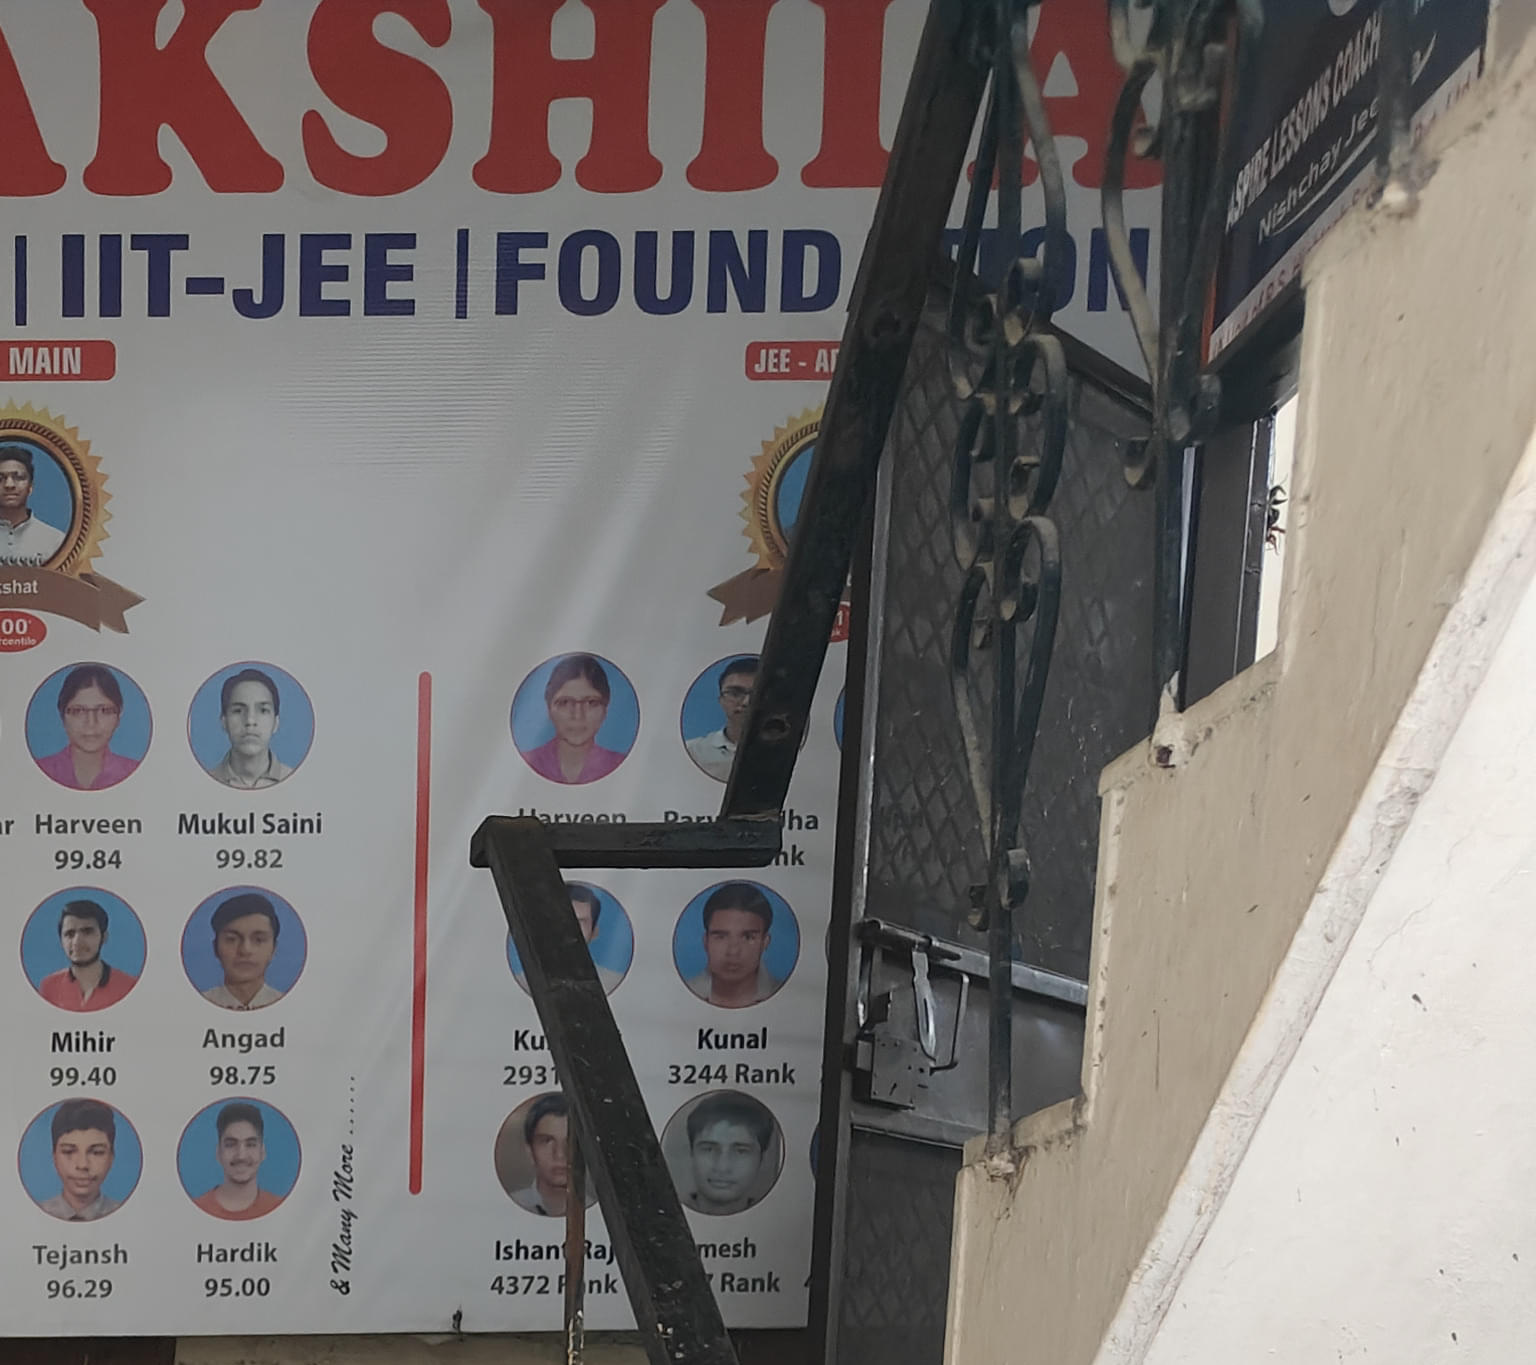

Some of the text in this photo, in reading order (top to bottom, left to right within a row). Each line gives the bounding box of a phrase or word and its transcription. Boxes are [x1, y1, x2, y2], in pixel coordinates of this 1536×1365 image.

[1270, 64, 1332, 180] LESSONS
[1333, 10, 1382, 107] COACH
[1258, 136, 1343, 245] Nishchay
[62, 232, 417, 320] IIT-JEE
[9, 346, 82, 375] MAIN
[754, 348, 791, 374] JEE
[35, 813, 142, 835] Harveen
[178, 812, 322, 835] Mukul Saini
[54, 850, 122, 870] 99.84
[216, 849, 283, 869] 99.82
[51, 1031, 115, 1053] Mihir
[202, 1026, 285, 1053] Angad
[697, 1028, 767, 1050] Kunal
[50, 1066, 116, 1087] 99.40
[210, 1066, 276, 1086] 98.75
[668, 1063, 796, 1085] 3244 Rank
[332, 1144, 355, 1201] More
[331, 1208, 358, 1273] Many
[32, 1244, 129, 1270] Tejansh
[197, 1242, 278, 1264] Hardik
[46, 1279, 113, 1299] 96.29
[204, 1278, 271, 1297] 95.00
[490, 1273, 618, 1295] 4372 Rnk
[720, 1271, 780, 1293] Rank
